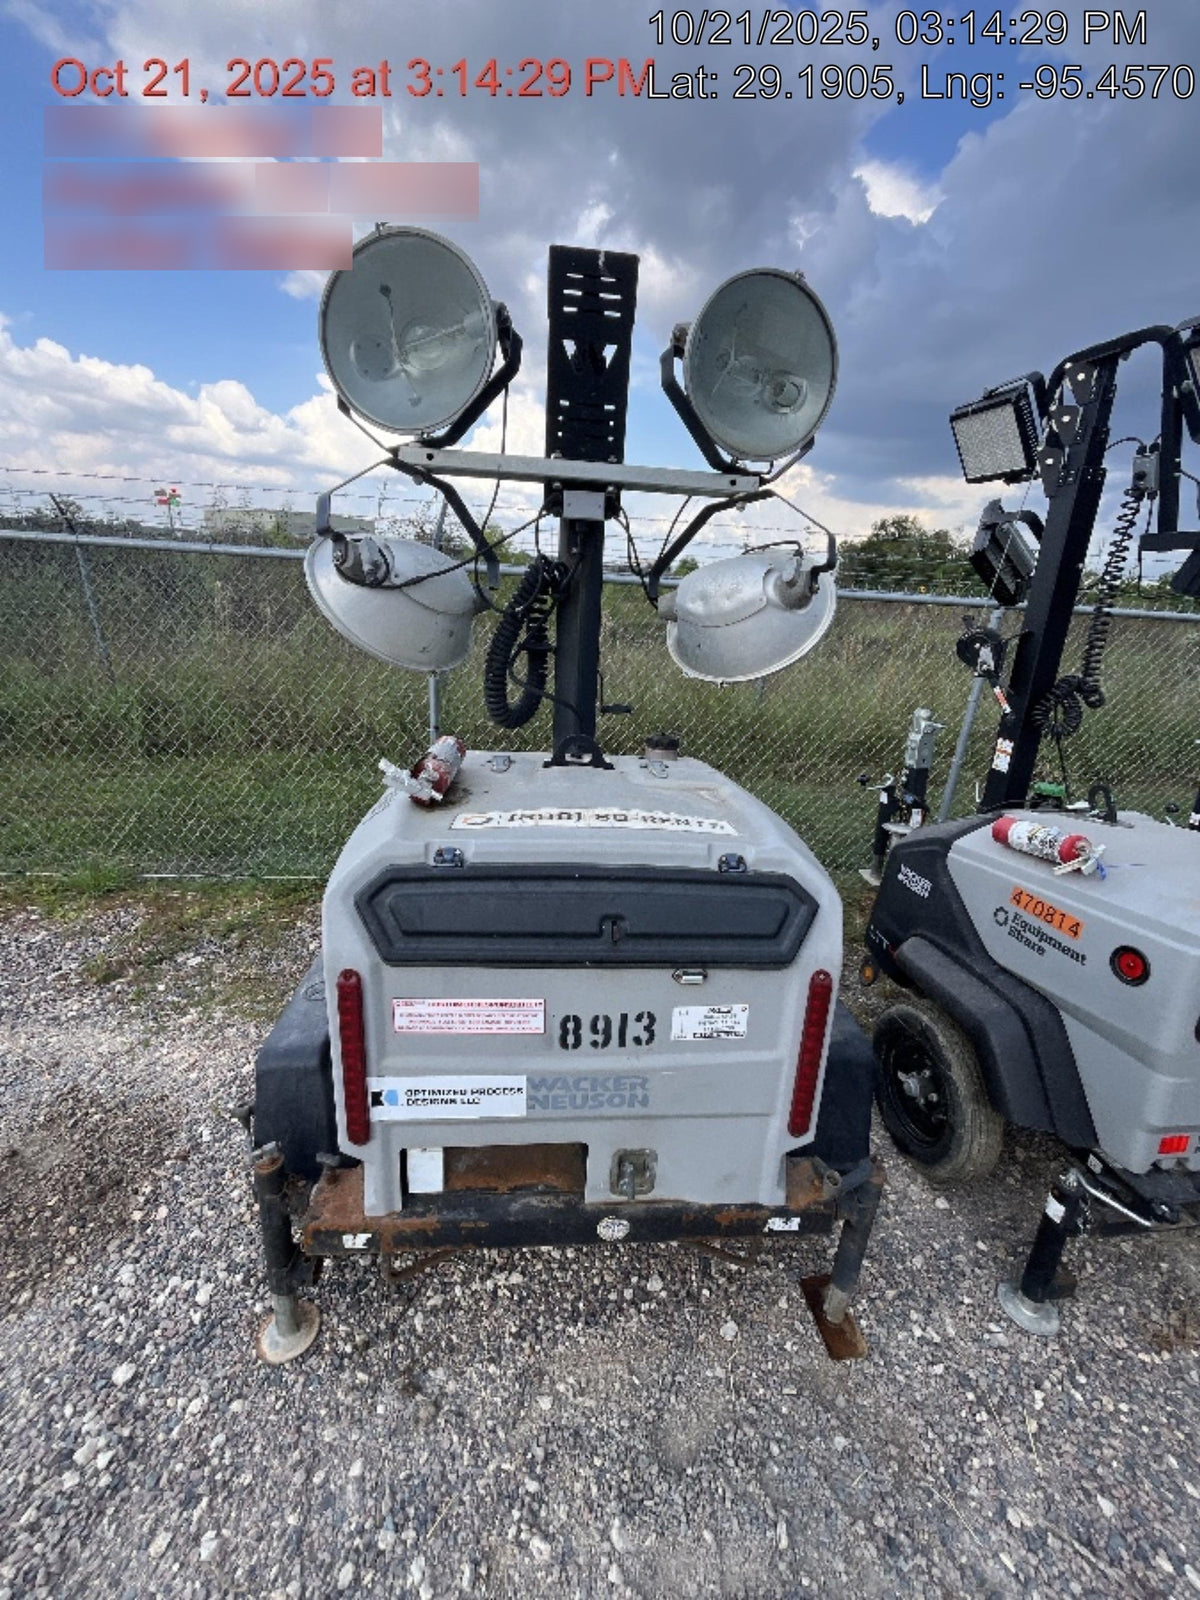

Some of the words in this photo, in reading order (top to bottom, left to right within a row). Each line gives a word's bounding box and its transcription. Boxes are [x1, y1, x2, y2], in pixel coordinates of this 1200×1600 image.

[1012, 889, 1081, 938] 470814
[1008, 925, 1047, 956] Share
[1010, 911, 1088, 966] Equipment
[558, 1010, 657, 1051] 8913
[404, 1088, 467, 1098] OPTIMIZED
[470, 1087, 524, 1097] PROCESS
[526, 1075, 649, 1092] WACKER
[460, 1096, 481, 1105] LLC
[526, 1093, 649, 1110] NEUSON
